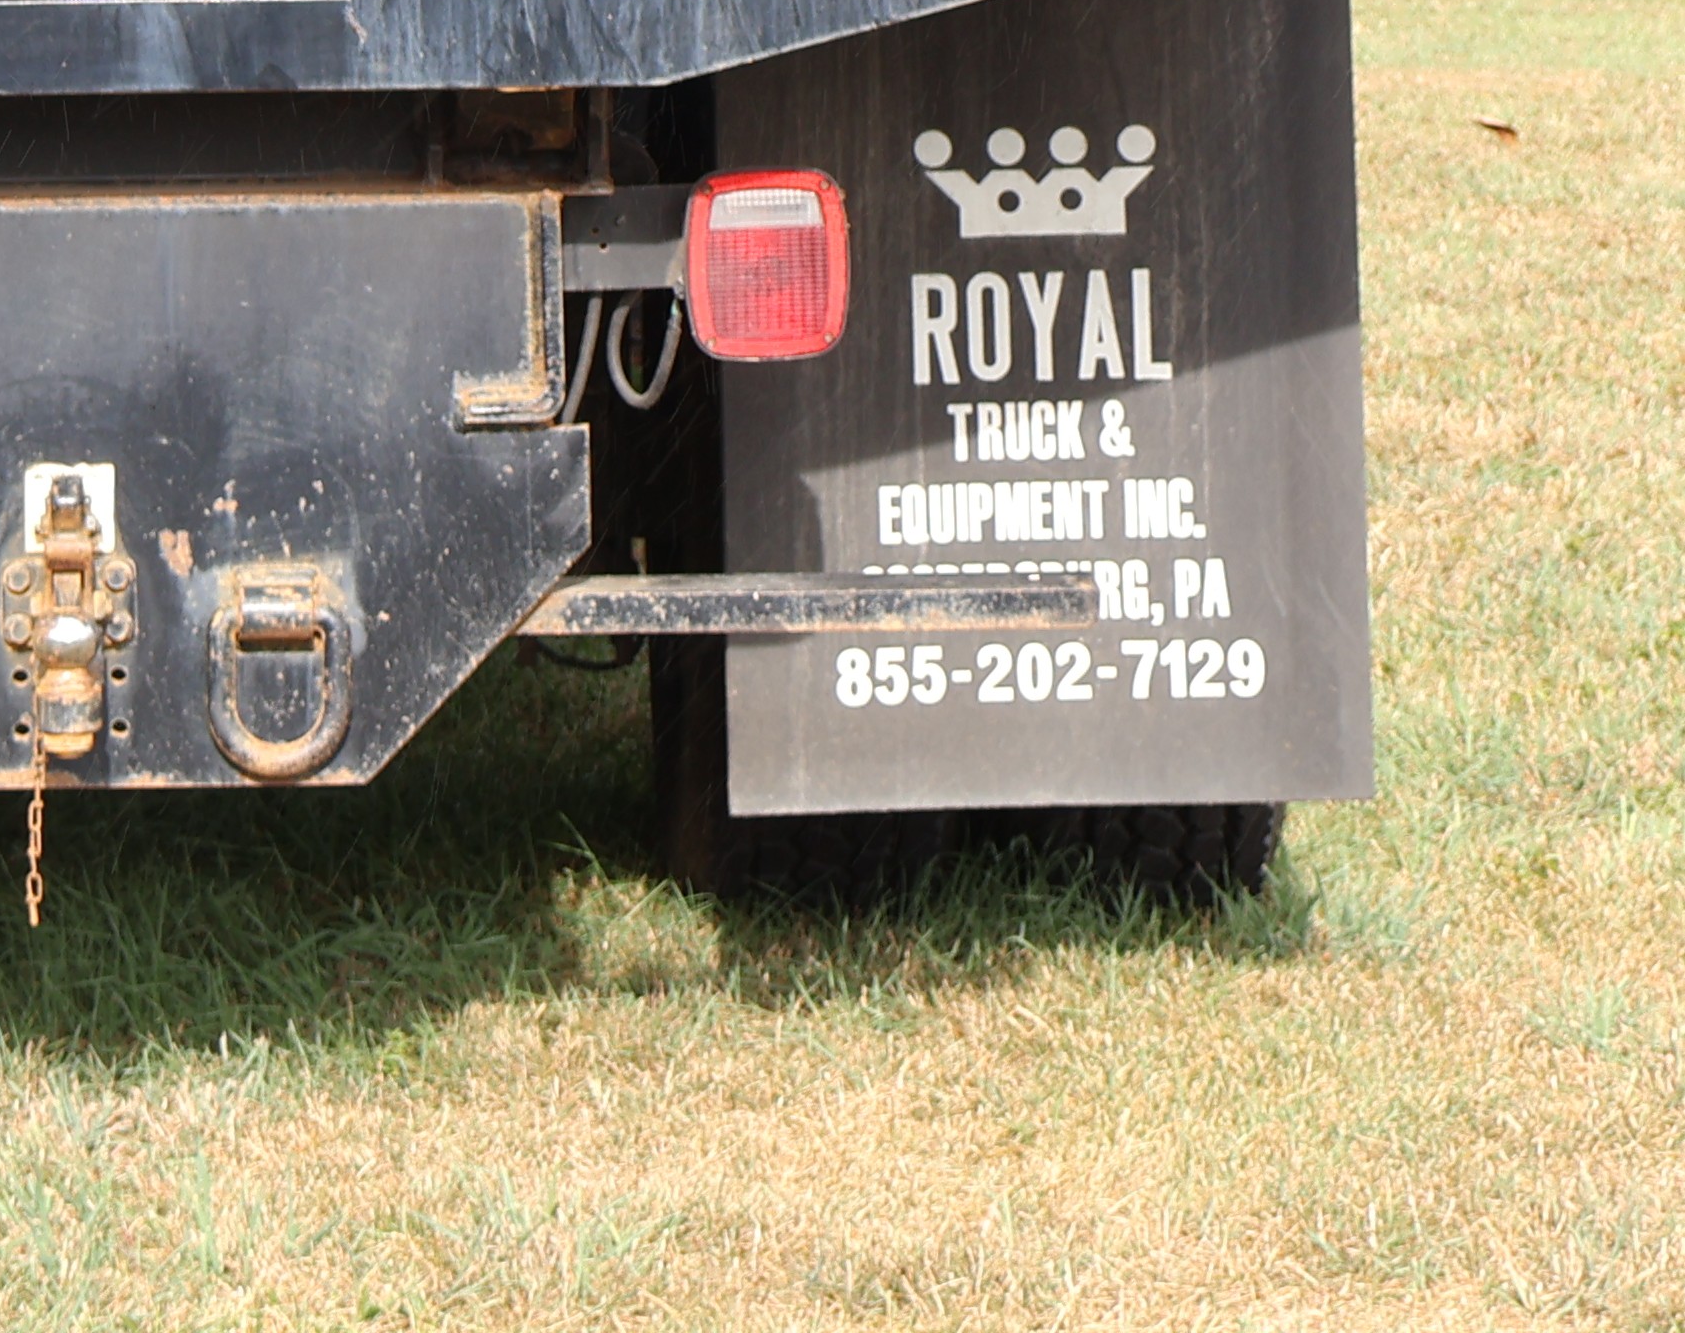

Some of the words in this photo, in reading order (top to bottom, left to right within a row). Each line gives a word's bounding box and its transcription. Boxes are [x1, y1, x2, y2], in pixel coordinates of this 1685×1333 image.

[911, 268, 1173, 385] ROYAL
[947, 399, 1085, 462] TRUCK
[1098, 398, 1136, 457] &
[878, 480, 1109, 546] EQUIPMENT
[1122, 476, 1207, 539] INC.
[1173, 557, 1231, 619] PA
[834, 638, 1266, 708] 855-202-7129
